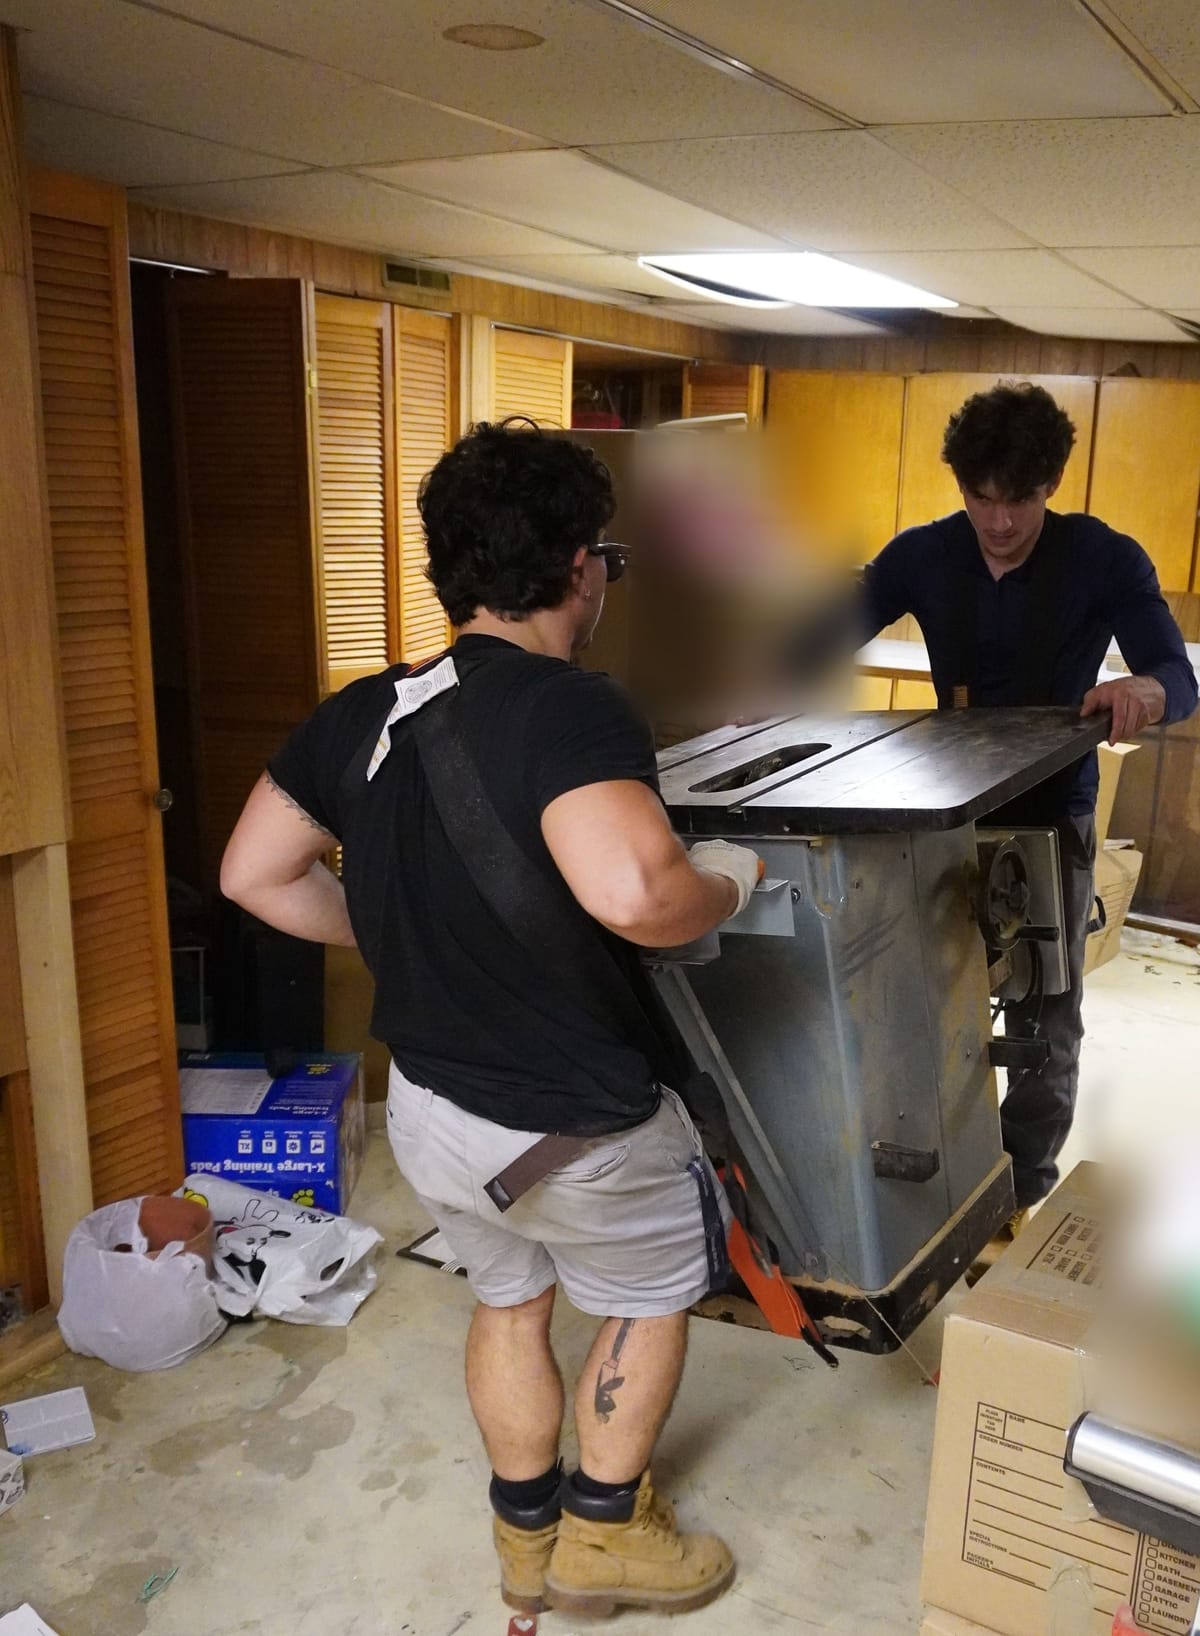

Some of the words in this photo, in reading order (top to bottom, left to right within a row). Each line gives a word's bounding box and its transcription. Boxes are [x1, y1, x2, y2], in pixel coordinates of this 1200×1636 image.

[191, 1161, 221, 1173] Pads
[224, 1159, 274, 1174] Training
[277, 1159, 325, 1173] X-Large
[1009, 1414, 1025, 1424] NAME
[999, 1441, 1023, 1452] NUMBER
[976, 1461, 1006, 1475] CONTENTS
[1159, 1552, 1196, 1570] KITCHEN
[1157, 1563, 1181, 1577] BATH
[1154, 1585, 1191, 1604] GARAGE
[1152, 1595, 1179, 1610] ATTIC
[1151, 1607, 1192, 1626] LAUNDRY
